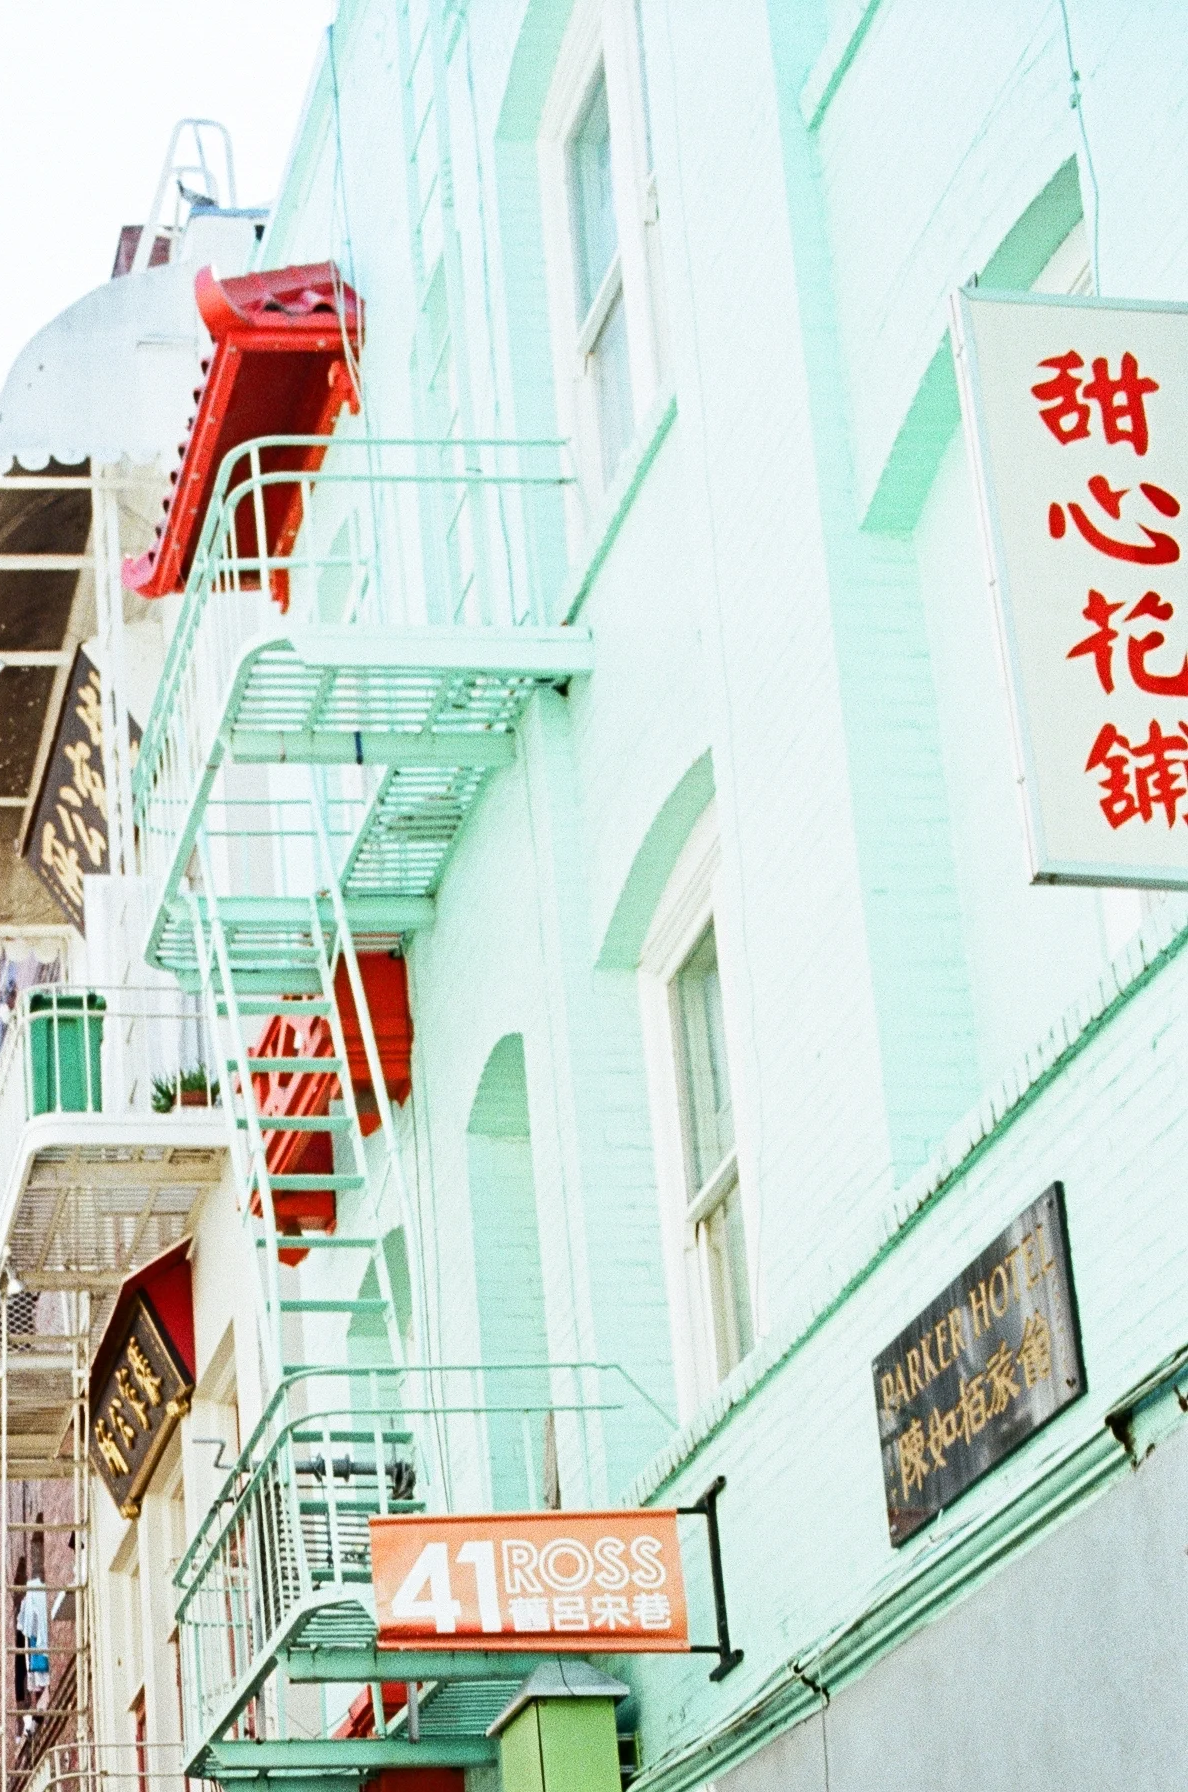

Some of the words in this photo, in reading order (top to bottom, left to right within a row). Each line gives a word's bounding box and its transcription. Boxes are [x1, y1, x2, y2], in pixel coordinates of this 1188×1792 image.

[879, 1306, 963, 1420] PARKER
[969, 1223, 1057, 1338] HOTEL
[392, 1540, 504, 1634] 41
[501, 1535, 667, 1594] ROSS
